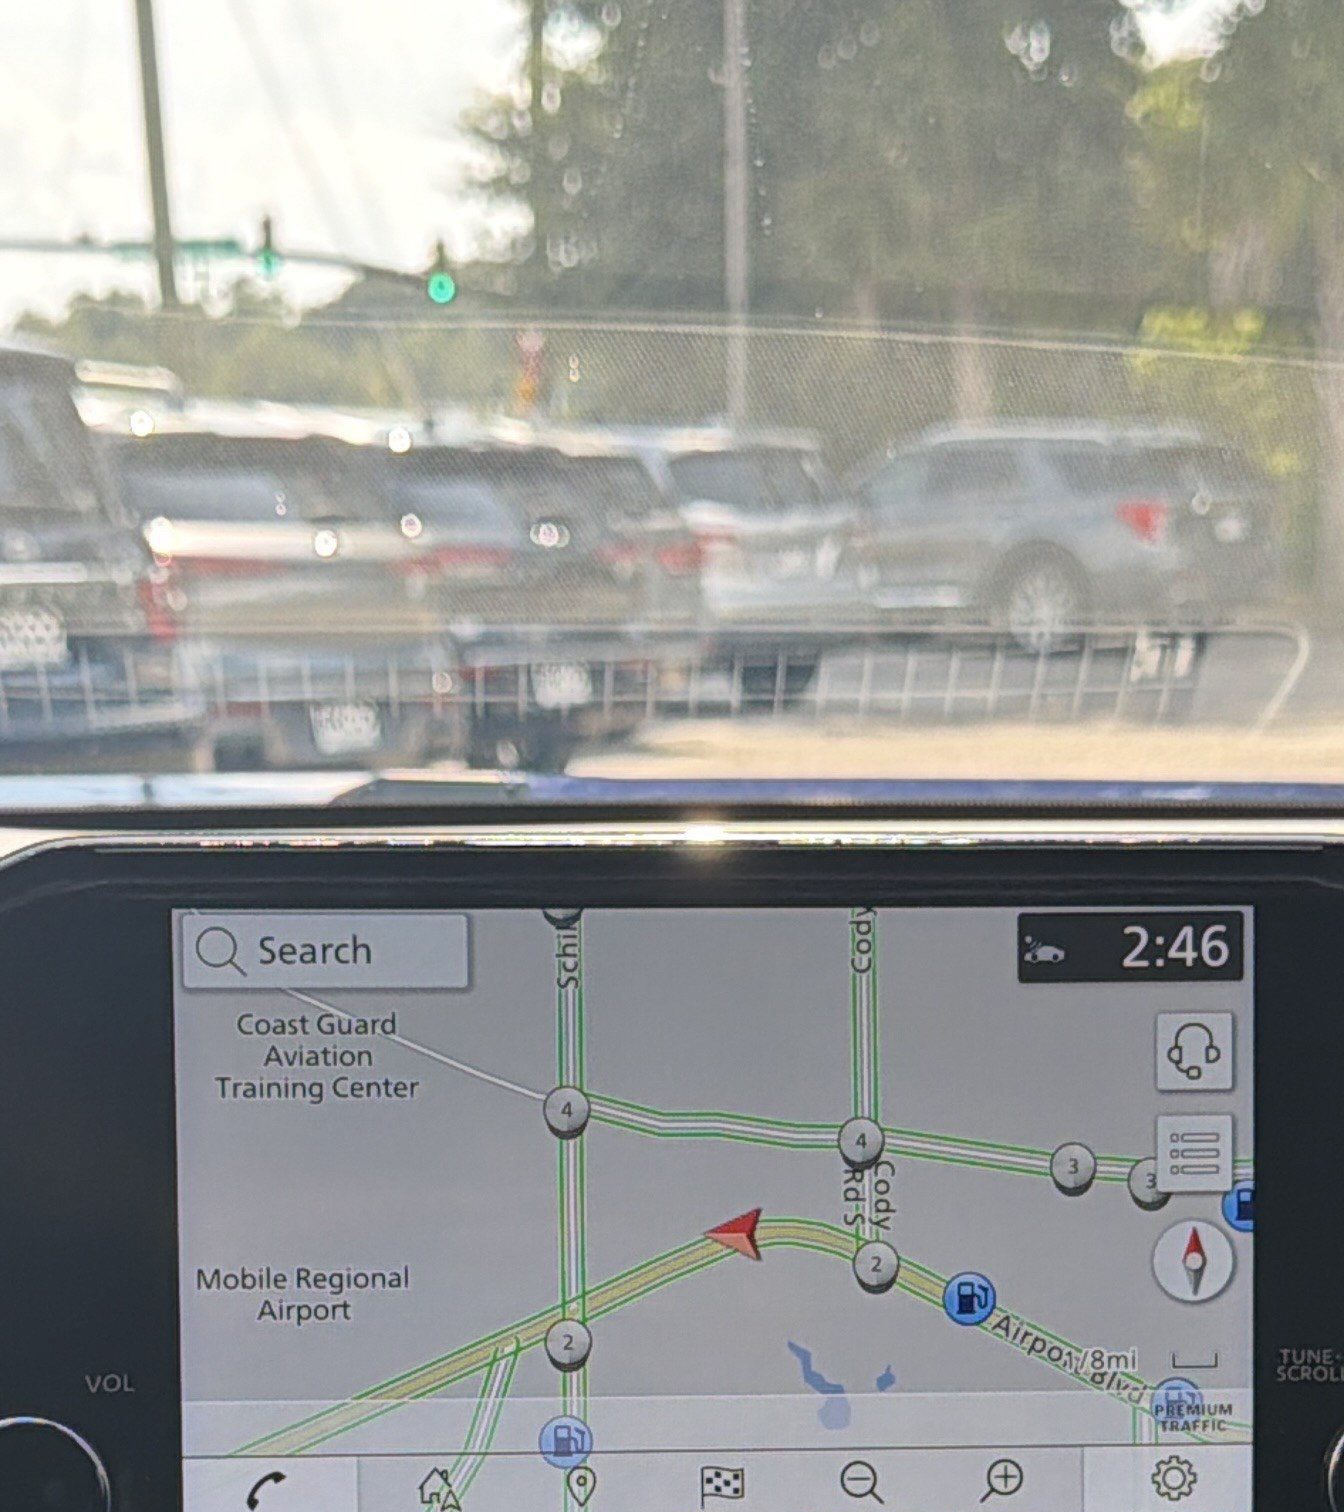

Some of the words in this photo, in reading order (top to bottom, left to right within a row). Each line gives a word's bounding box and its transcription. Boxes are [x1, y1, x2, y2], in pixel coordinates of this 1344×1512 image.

[259, 935, 371, 965] Search
[1122, 924, 1230, 968] 2:46
[237, 1015, 309, 1036] Coast
[317, 1013, 396, 1036] Guard
[263, 1044, 373, 1067] Aviation
[215, 1076, 324, 1104] Training
[332, 1076, 420, 1099] Center
[561, 1101, 573, 1118] 4
[855, 1132, 867, 1149] 4
[1068, 1157, 1079, 1175] 3
[843, 1168, 866, 1202] Rd
[1145, 1172, 1157, 1190] 3
[868, 1160, 896, 1231] Cody
[843, 1213, 866, 1226] S
[870, 1255, 882, 1273] 2
[196, 1267, 288, 1292] Mobile
[297, 1266, 410, 1294] Regional
[257, 1301, 352, 1325] Airport
[563, 1334, 574, 1351] 2
[84, 1373, 136, 1394] VOL
[1155, 1403, 1233, 1417] PREMIUM
[1160, 1419, 1227, 1433] TRAFFIC
